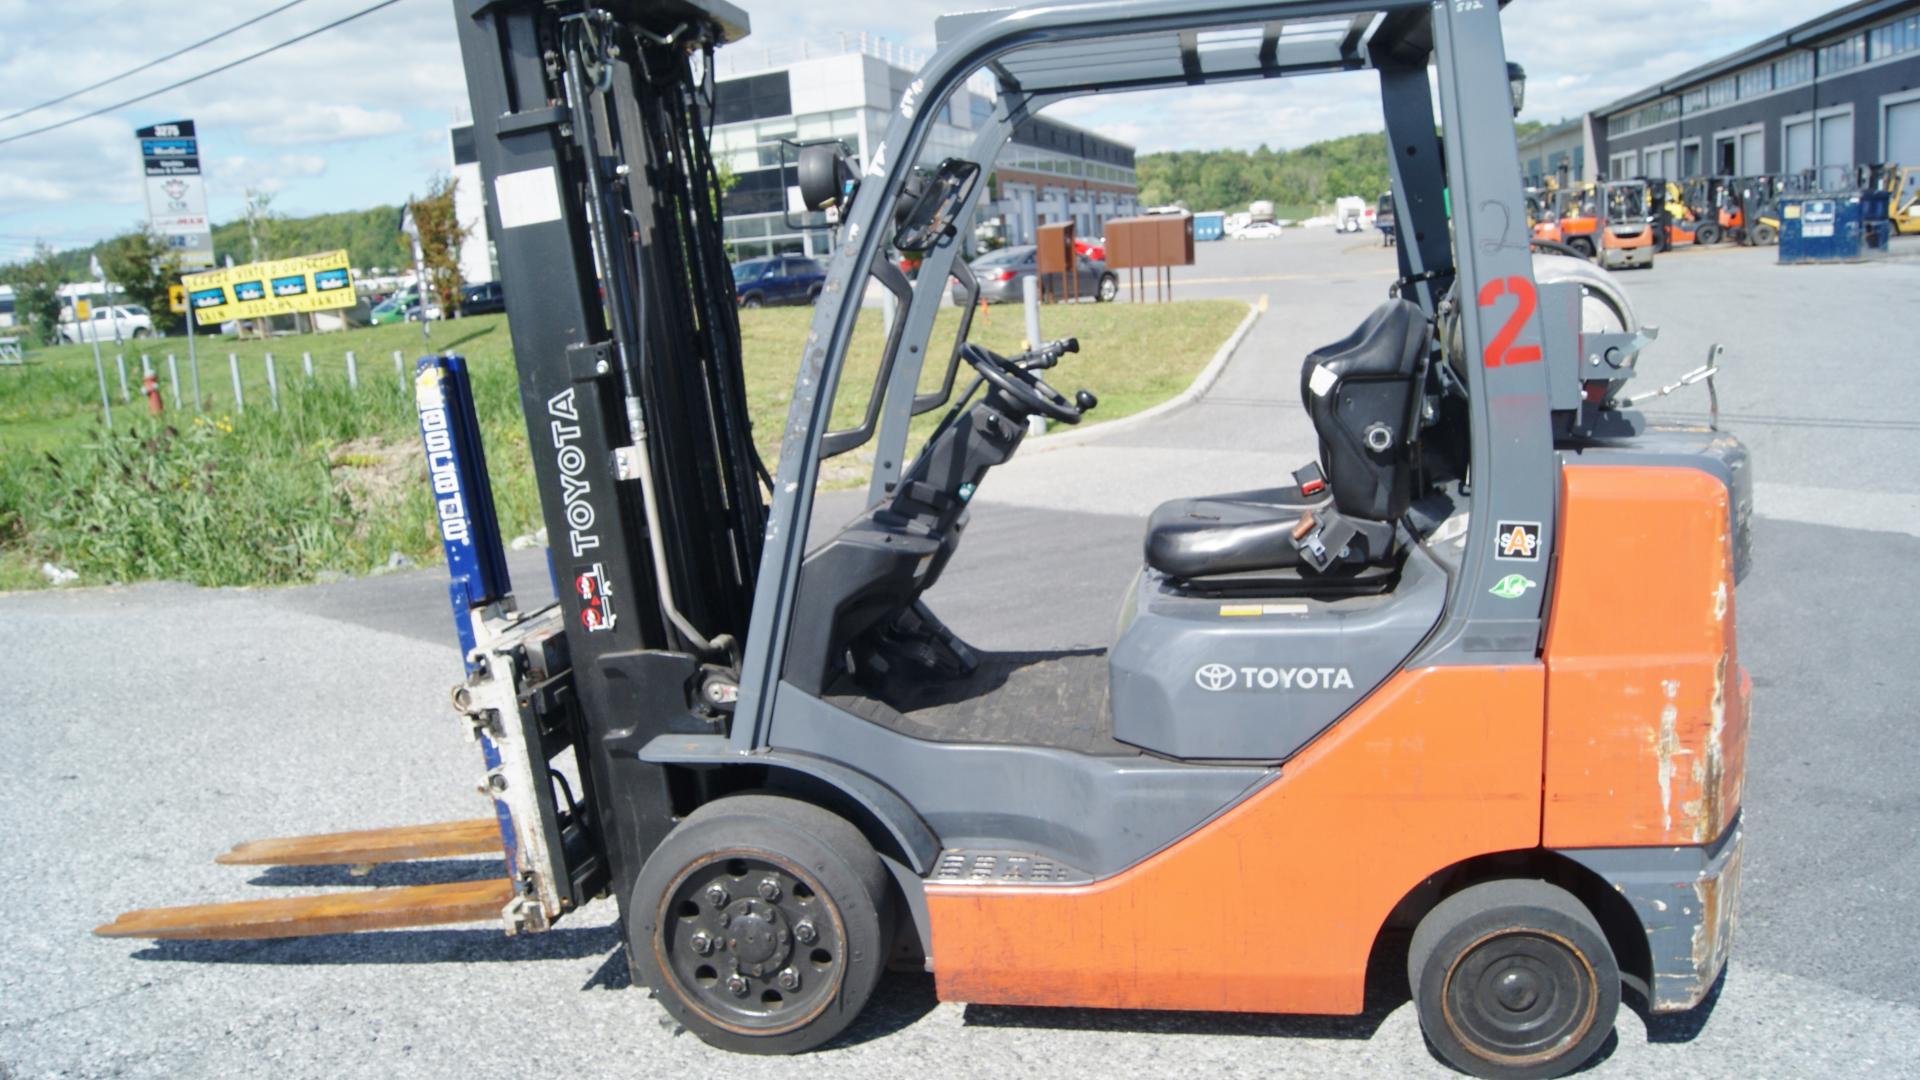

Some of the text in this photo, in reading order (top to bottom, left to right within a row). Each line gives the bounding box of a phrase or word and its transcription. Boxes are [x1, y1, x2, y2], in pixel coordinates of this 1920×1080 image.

[1477, 275, 1542, 369] 2
[419, 396, 469, 546] ascade
[548, 387, 600, 557] TOYOTA
[1500, 526, 1537, 557] SAS
[1240, 667, 1354, 690] TOYOTA
